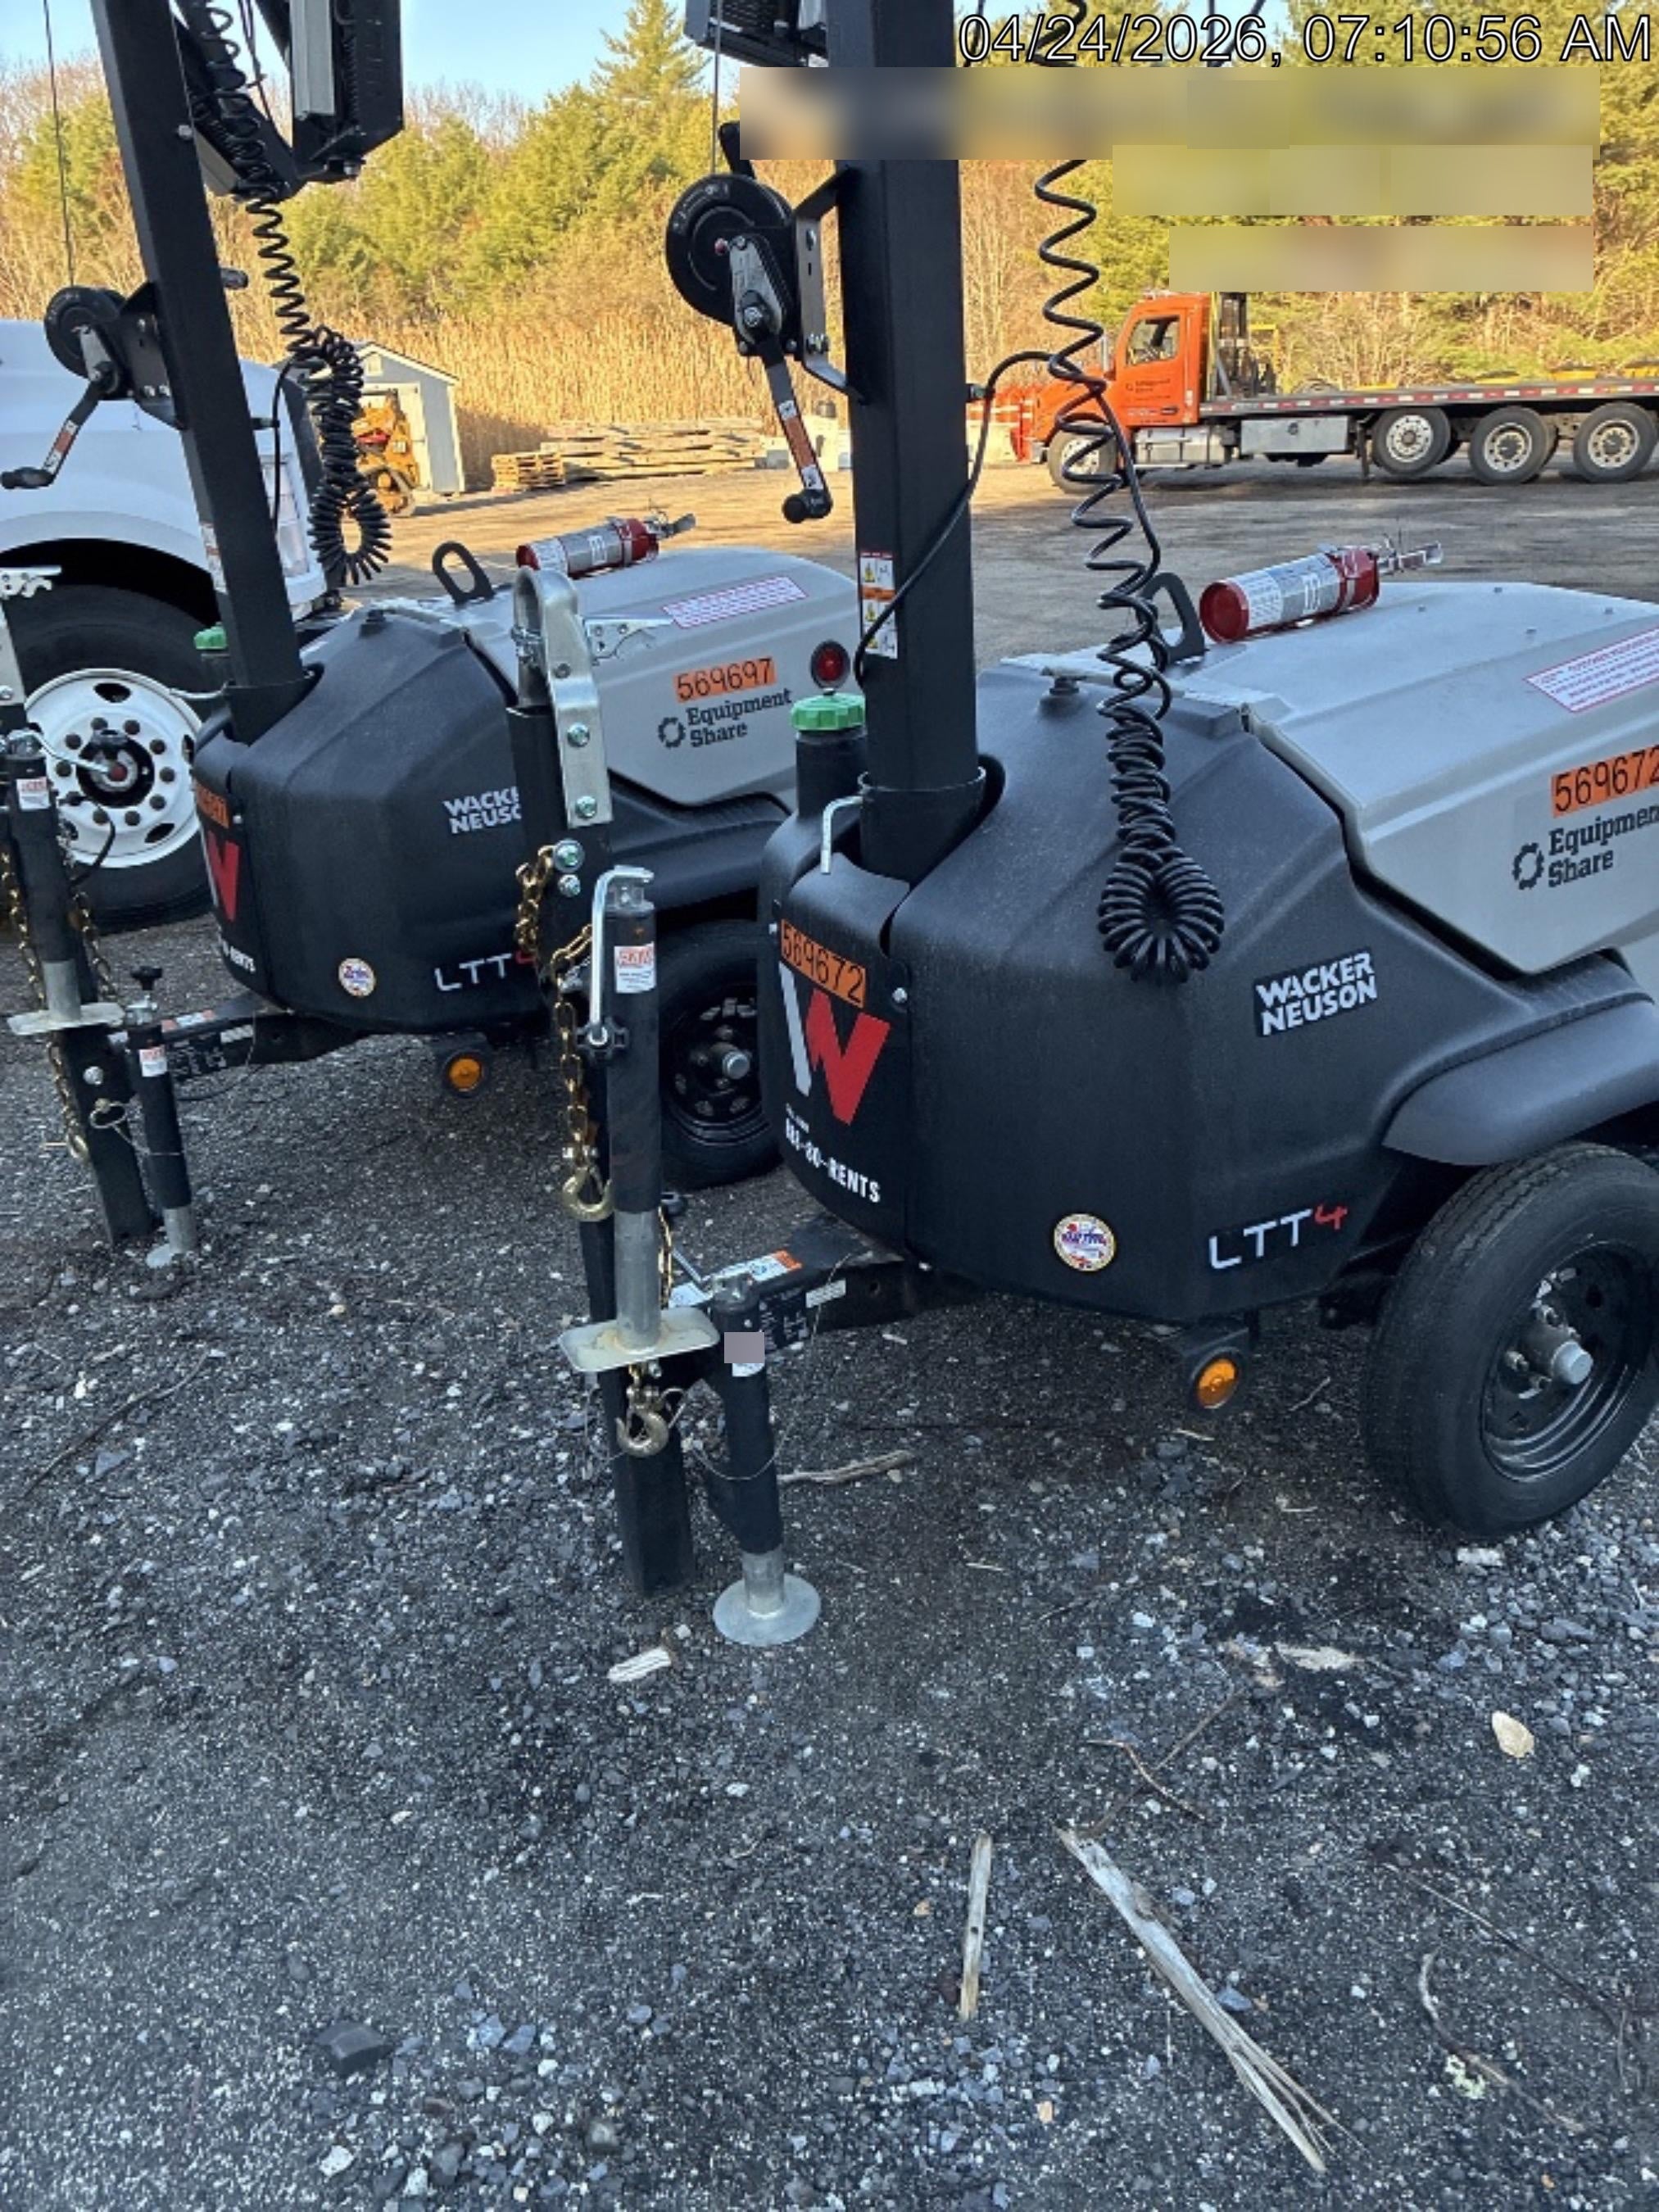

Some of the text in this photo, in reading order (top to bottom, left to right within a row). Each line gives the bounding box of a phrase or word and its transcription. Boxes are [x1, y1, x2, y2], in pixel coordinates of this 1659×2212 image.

[677, 657, 772, 700] 569697
[686, 688, 793, 726] Equipment
[690, 723, 748, 747] Share
[1548, 805, 1659, 857] Equipmen
[1548, 850, 1614, 888] Share
[783, 922, 863, 1004] 569672
[1256, 951, 1375, 1008] WACKER
[1262, 975, 1377, 1036] NEUSON
[1208, 1204, 1348, 1269] LTT4
